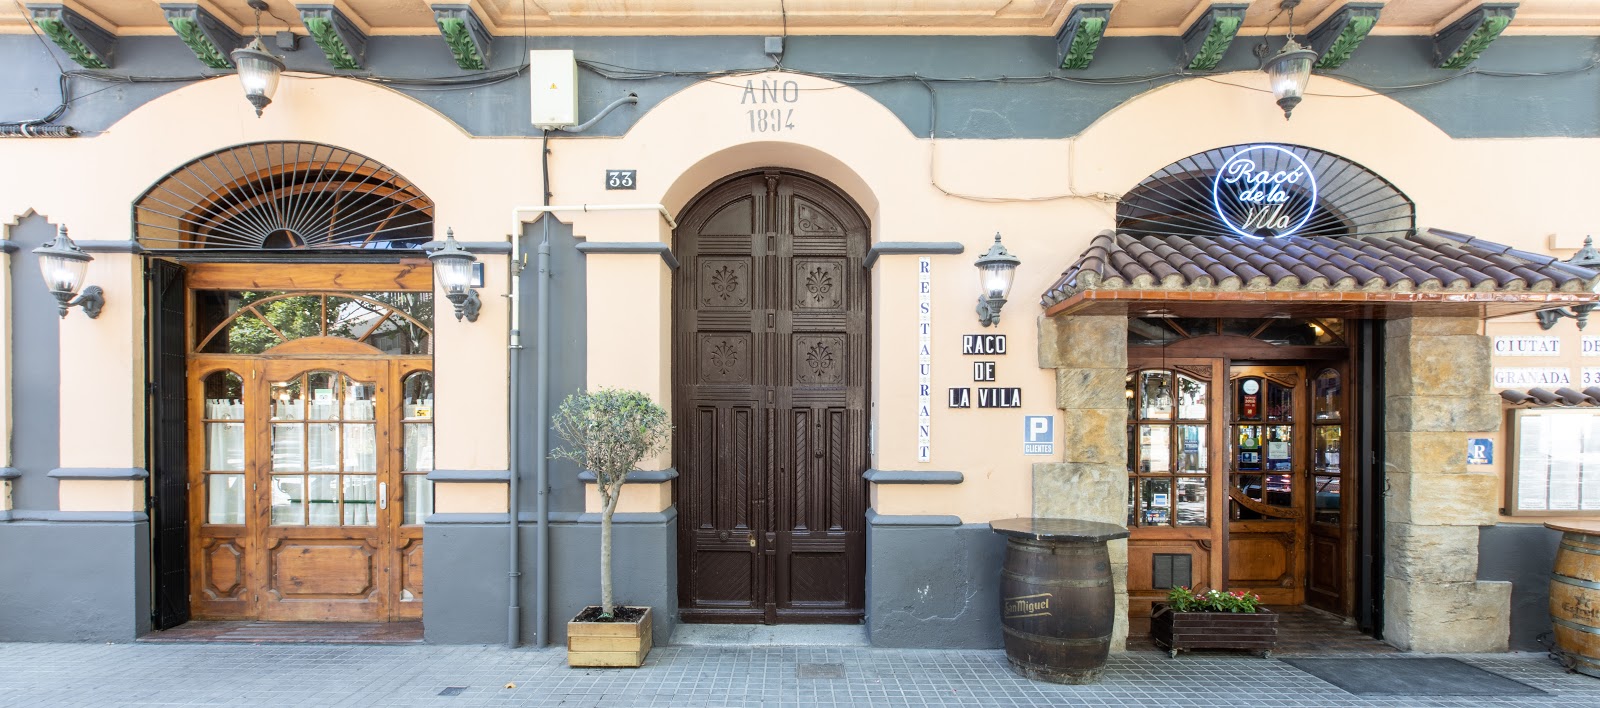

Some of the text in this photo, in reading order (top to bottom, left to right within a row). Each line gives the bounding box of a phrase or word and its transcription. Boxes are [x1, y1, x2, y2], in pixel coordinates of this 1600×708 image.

[746, 108, 795, 133] 1894
[609, 171, 633, 187] 33
[1225, 158, 1304, 184] Racó
[1239, 183, 1290, 202] de la
[1241, 203, 1290, 230] Vila
[962, 335, 1007, 354] RACO
[1495, 339, 1559, 352] CIUTAT
[920, 261, 930, 458] RESTAURANT
[974, 362, 995, 381] DE
[1495, 371, 1600, 384] GRANADA 33
[949, 388, 1021, 407] LA VILA
[1029, 417, 1048, 442] P
[1025, 444, 1052, 454] CLIENTES
[1474, 444, 1486, 459] R
